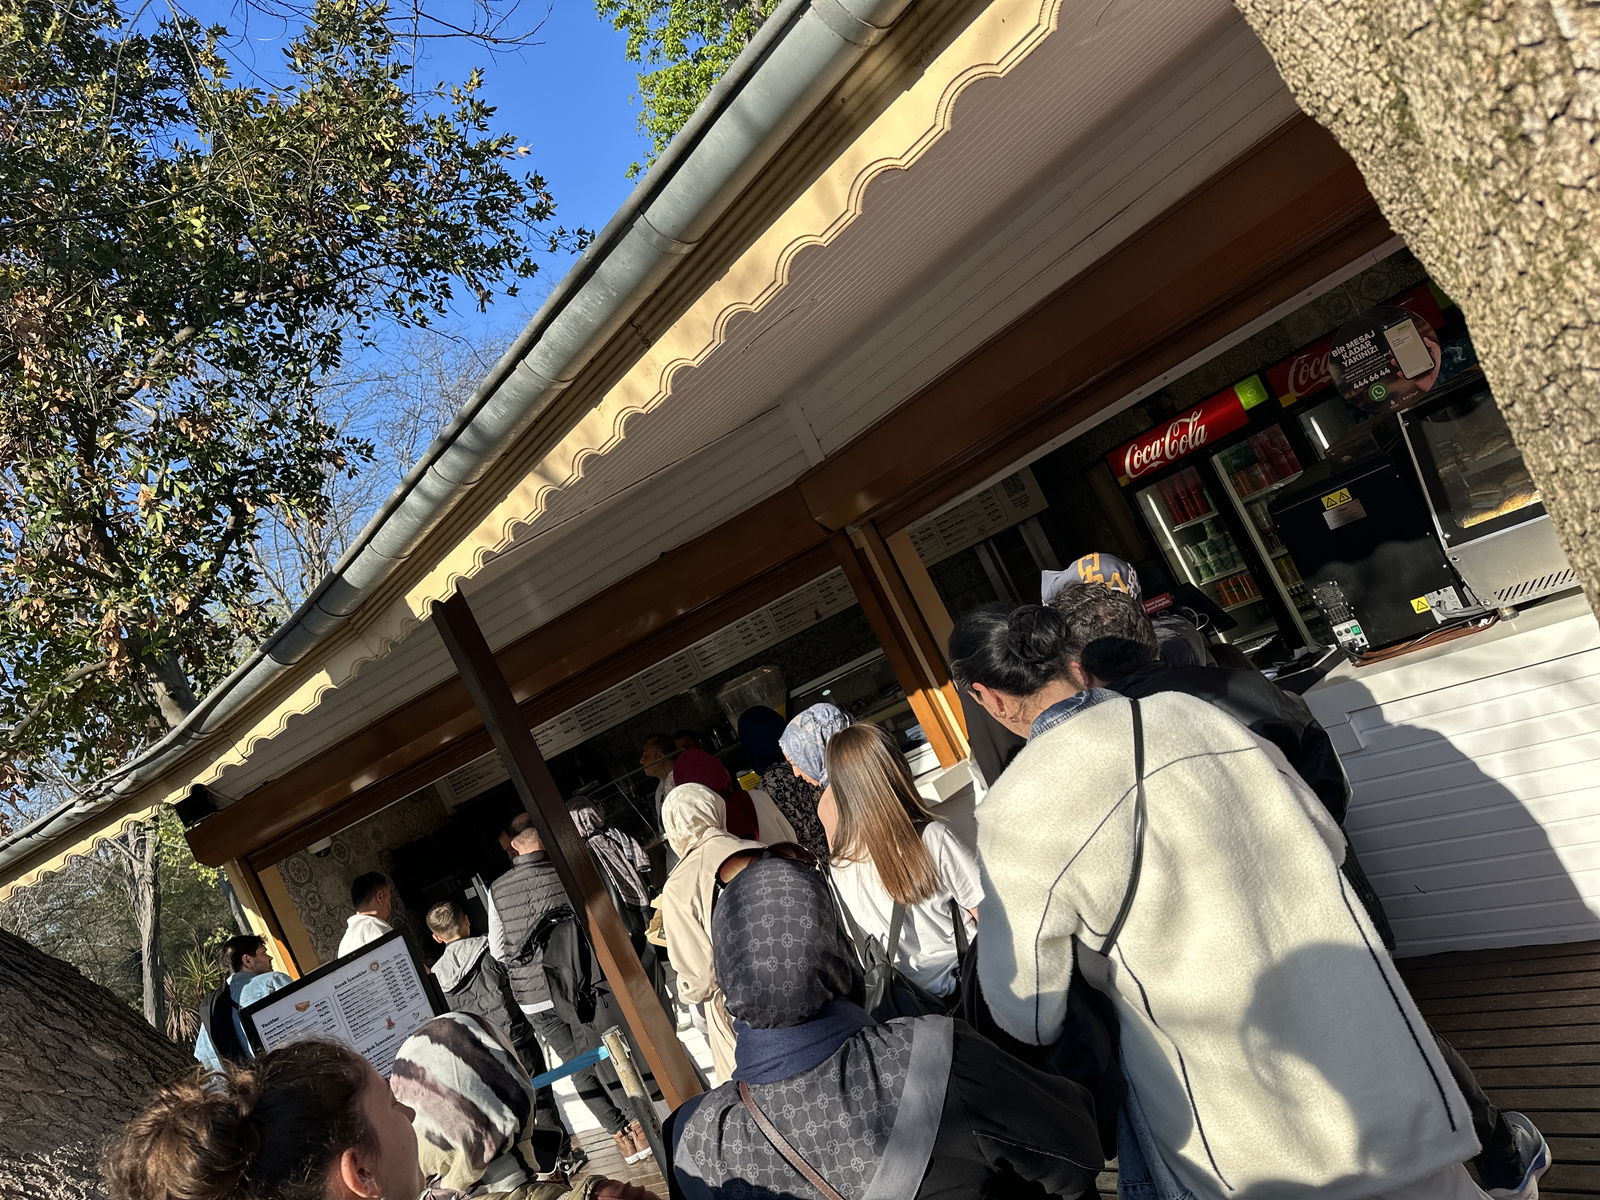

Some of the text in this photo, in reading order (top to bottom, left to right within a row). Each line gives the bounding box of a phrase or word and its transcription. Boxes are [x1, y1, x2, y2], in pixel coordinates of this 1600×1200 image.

[1331, 344, 1347, 358] BİR
[1345, 330, 1377, 349] MESAJ
[1341, 341, 1372, 361] KADAR
[1342, 345, 1379, 368] YAKINIZ!
[1353, 367, 1391, 390] 444 66 44
[1123, 408, 1208, 479] Coca-Cola
